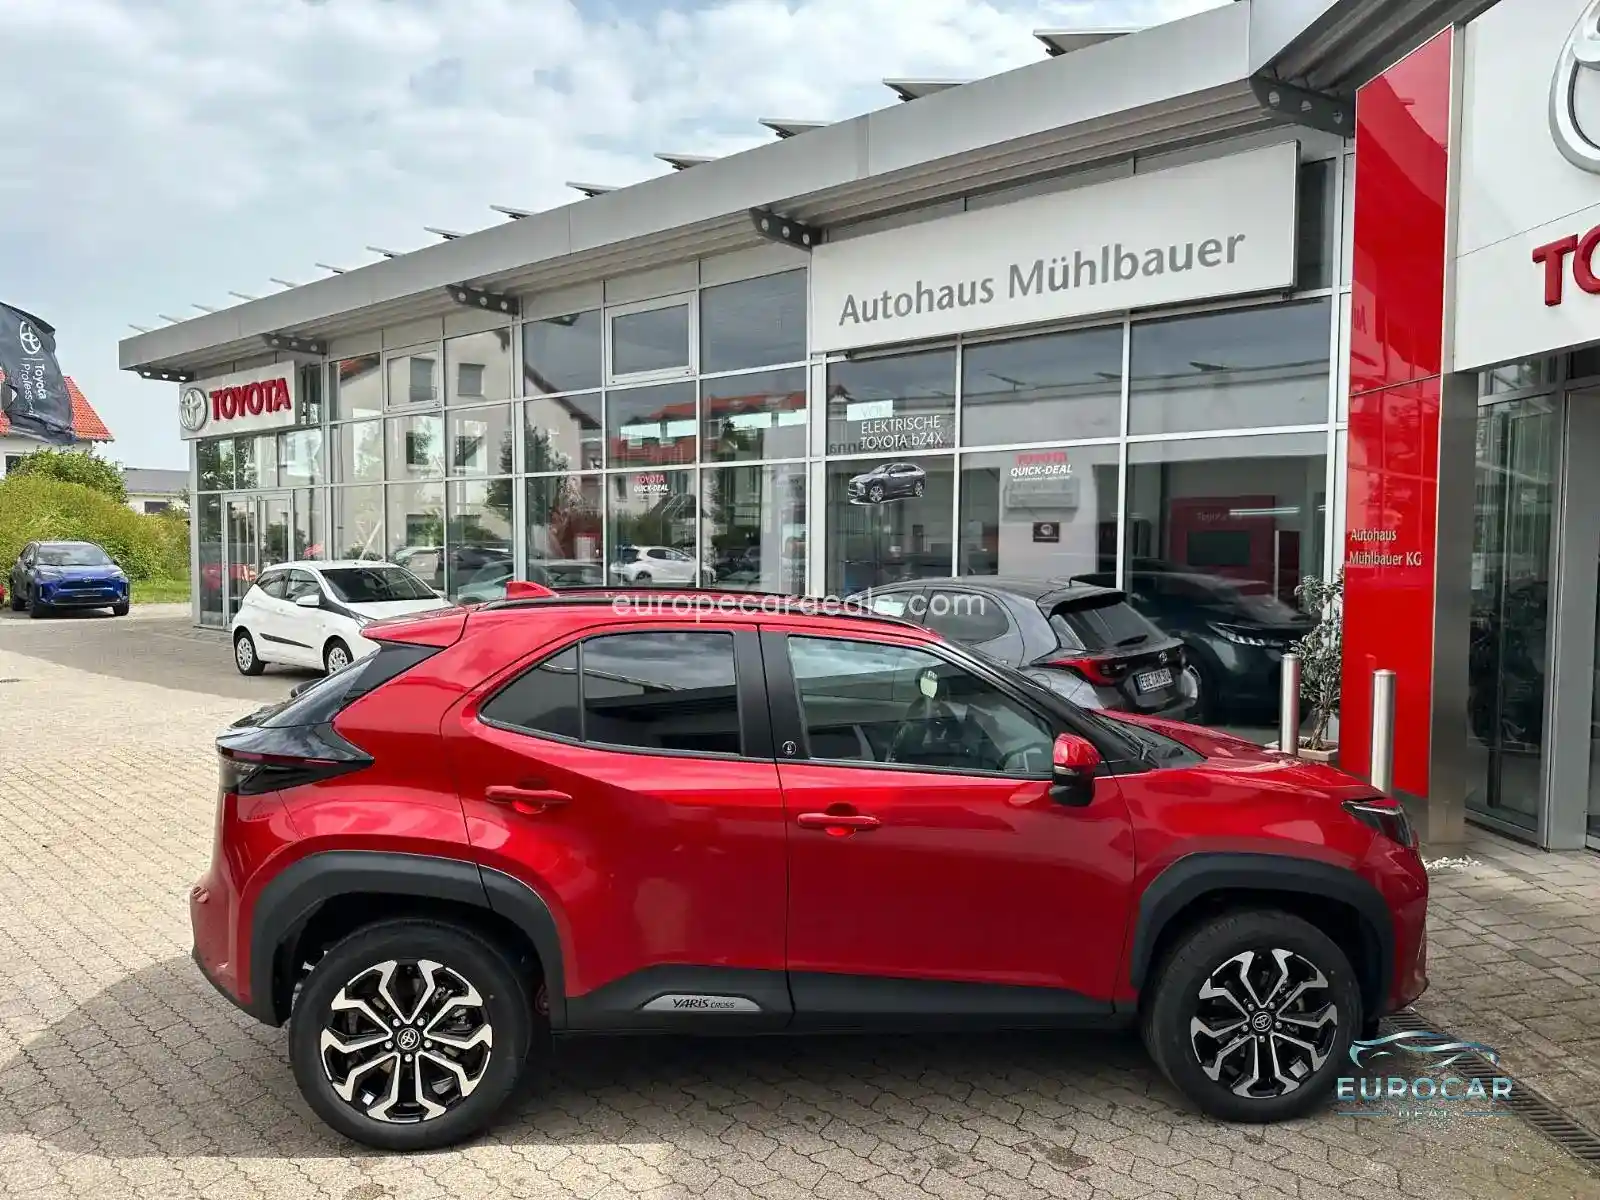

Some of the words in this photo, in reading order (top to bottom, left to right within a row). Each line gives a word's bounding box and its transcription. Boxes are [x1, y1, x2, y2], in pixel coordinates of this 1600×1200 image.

[838, 276, 995, 326] Autohaus
[1008, 232, 1246, 299] Mühlbauer
[33, 363, 47, 400] Toyota
[209, 377, 292, 421] TOYOTA
[861, 415, 941, 434] ELEKTRISCHE
[860, 433, 908, 449] TOYOTA
[911, 431, 943, 446] bZ4X
[1010, 464, 1072, 477] QUICK-DEAL
[635, 473, 665, 484] TOYOTA
[633, 484, 669, 493] QUICK-DEAL
[1350, 528, 1397, 541] Autohaus
[1349, 551, 1403, 566] Mühlbauer
[1406, 551, 1422, 566] KG
[672, 998, 709, 1009] YARIS
[710, 1001, 735, 1009] CROSS
